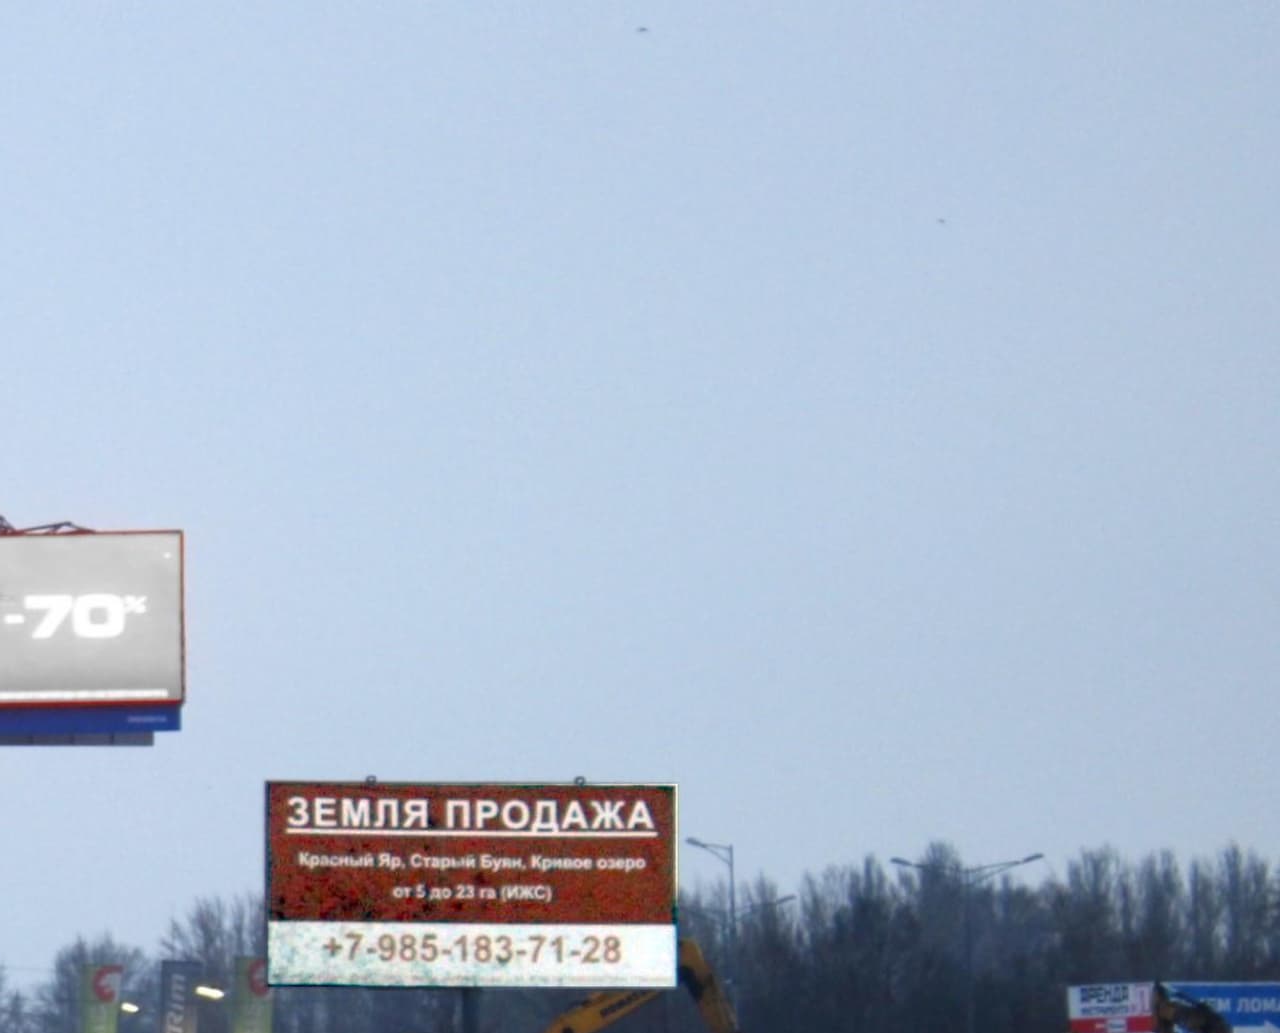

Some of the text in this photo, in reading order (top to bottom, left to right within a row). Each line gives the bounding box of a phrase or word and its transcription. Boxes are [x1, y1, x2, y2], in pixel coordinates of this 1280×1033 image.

[287, 797, 655, 832] ЗЕМЛЯ ПРОДАЖА
[298, 852, 375, 870] Красный
[410, 853, 476, 872] Старый
[530, 855, 593, 872] Кривое
[596, 858, 647, 873] озеро
[392, 884, 553, 902] от 5 до 23 га (ИЖС)
[323, 933, 622, 963] +7-985-183-71-28
